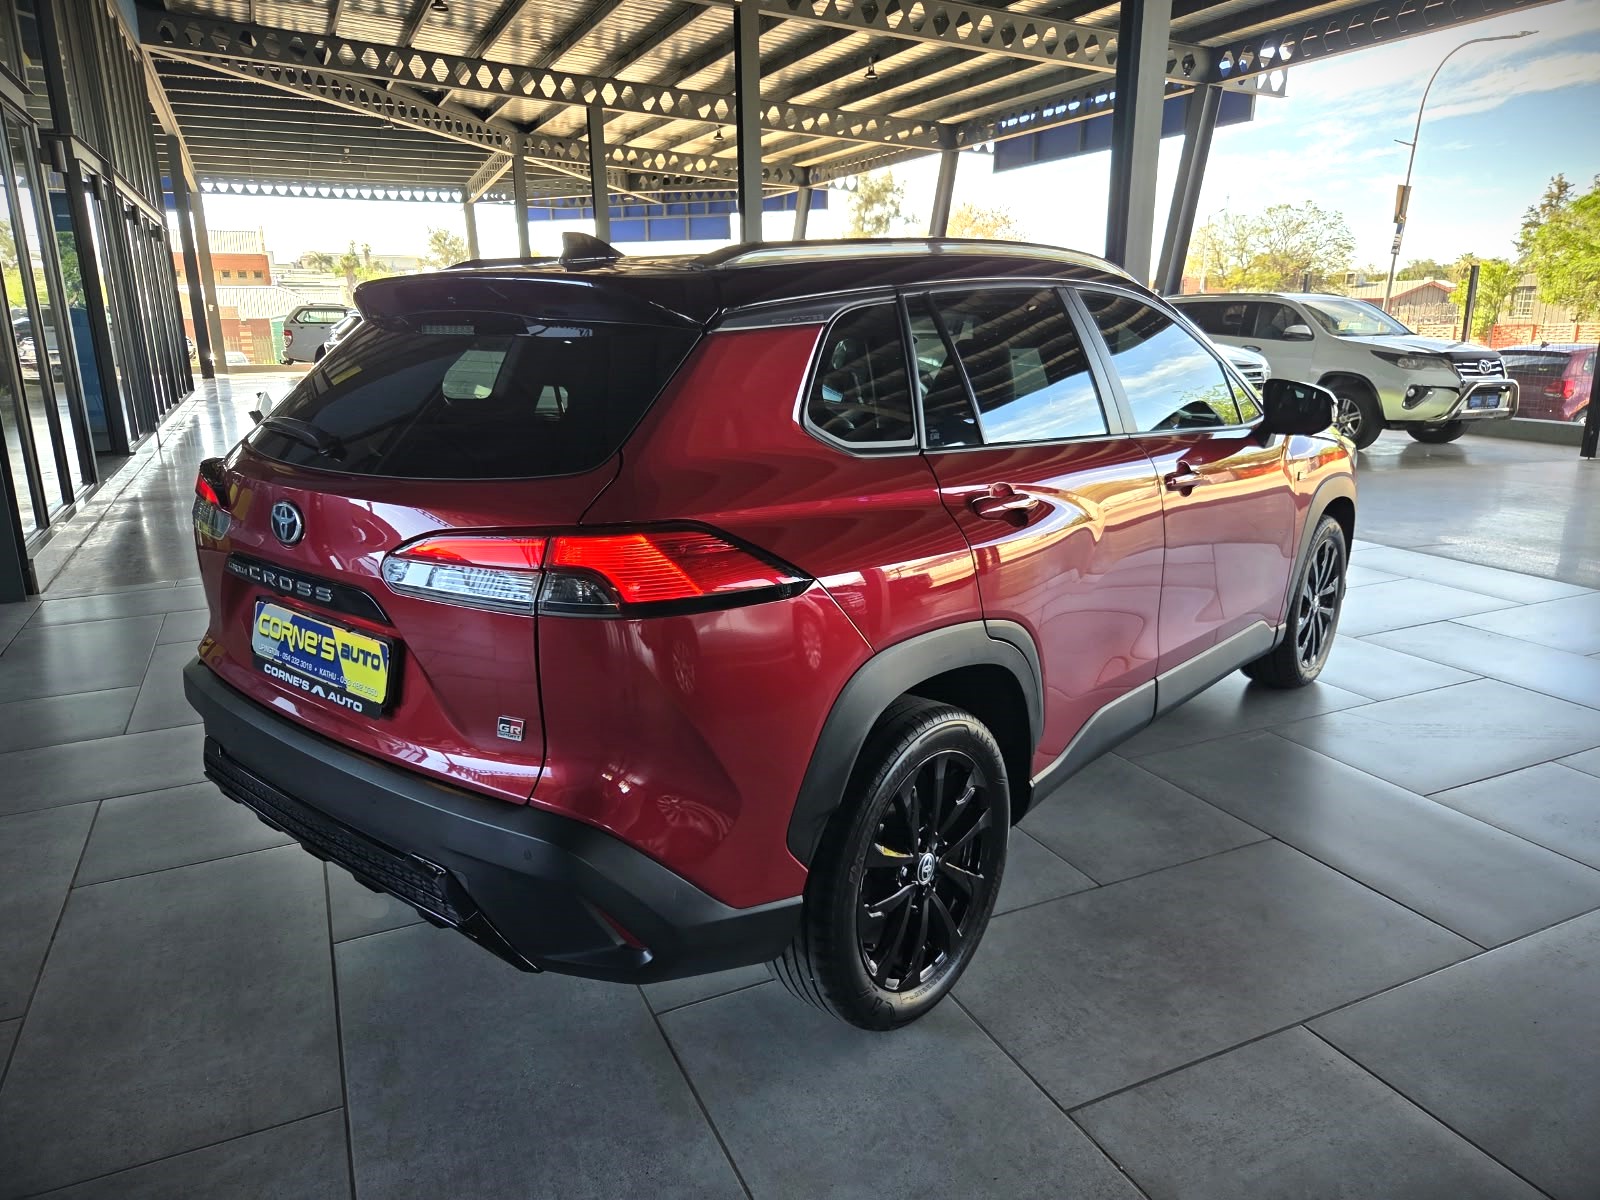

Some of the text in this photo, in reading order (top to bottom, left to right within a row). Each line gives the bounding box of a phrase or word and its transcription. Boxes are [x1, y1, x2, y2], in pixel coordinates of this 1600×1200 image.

[249, 565, 333, 602] CROSS
[319, 667, 337, 681] KATHU
[264, 663, 363, 713] CORNE'S AUTO
[499, 723, 521, 735] GR
